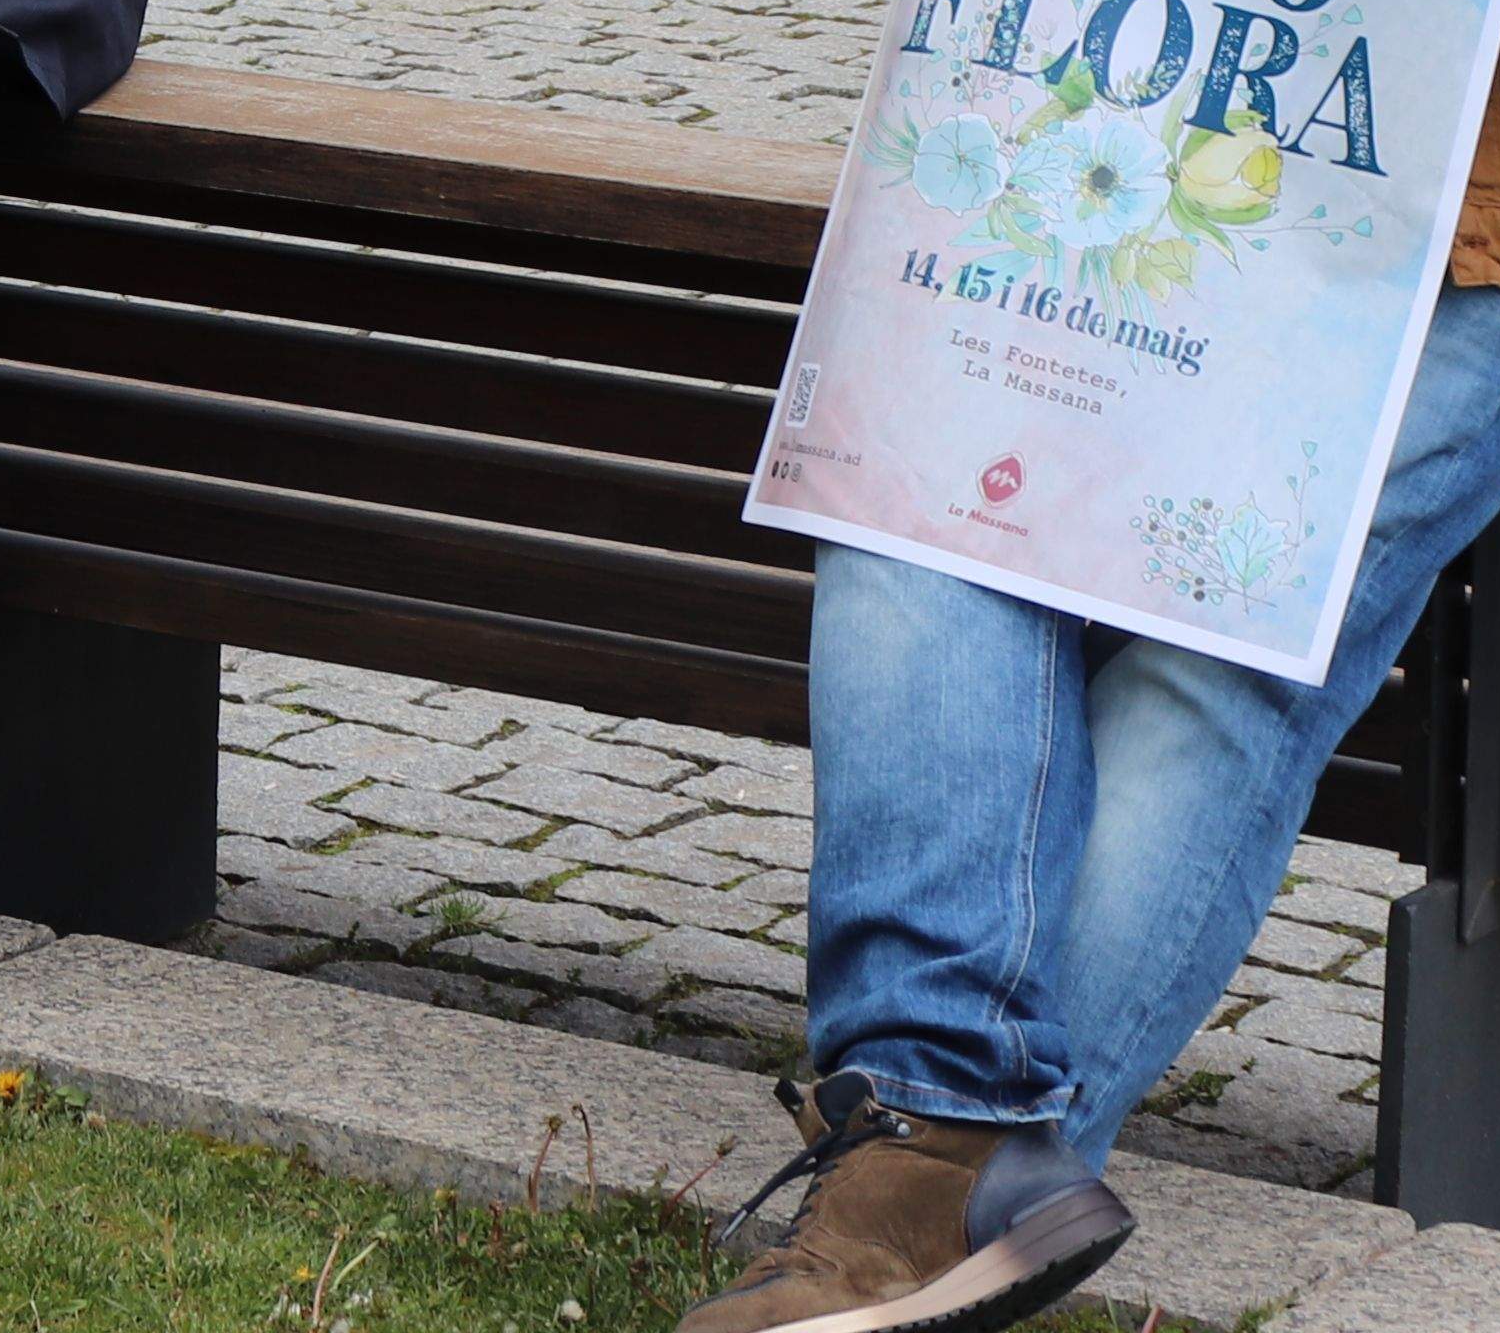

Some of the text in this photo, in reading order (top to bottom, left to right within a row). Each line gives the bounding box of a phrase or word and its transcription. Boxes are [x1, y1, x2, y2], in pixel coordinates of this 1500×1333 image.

[899, 249, 1210, 377] 14, 15 i 16 de maig
[950, 328, 1128, 398] Les Fontetes,
[963, 359, 1103, 415] La Massana
[948, 502, 1029, 537] La Massana
